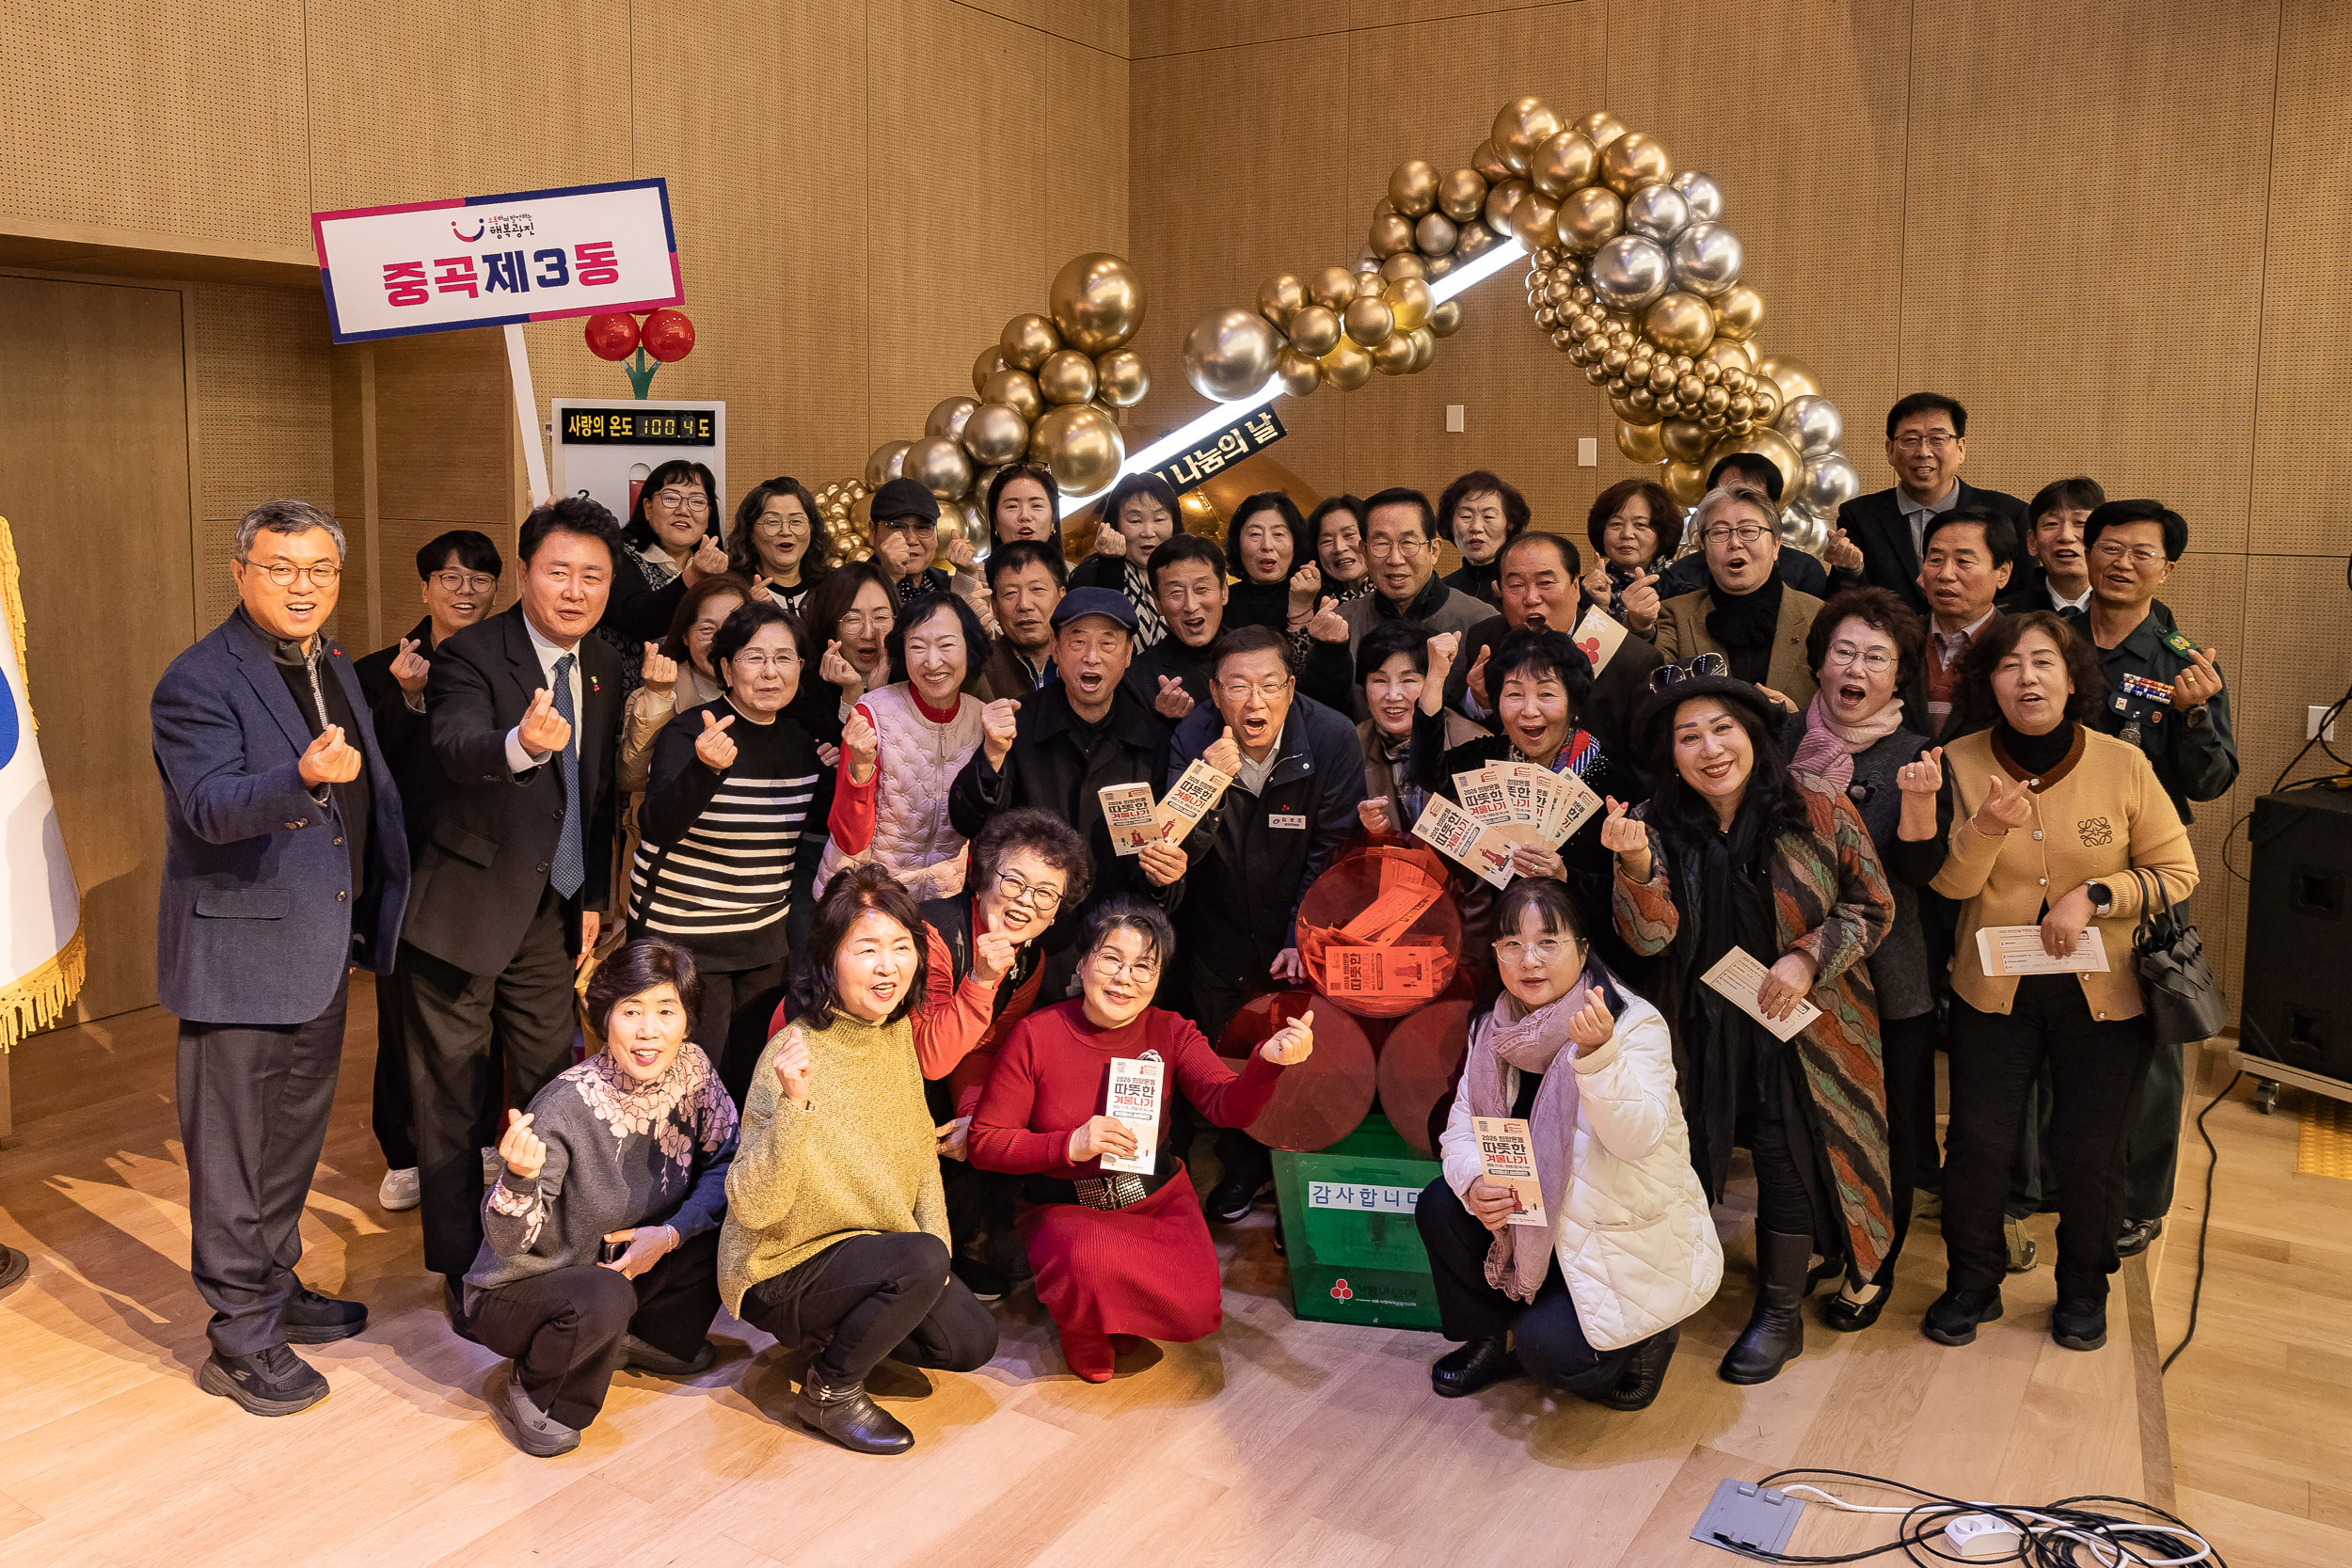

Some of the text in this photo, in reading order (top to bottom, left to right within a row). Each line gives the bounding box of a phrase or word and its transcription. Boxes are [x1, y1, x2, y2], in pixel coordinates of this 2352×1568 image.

[489, 222, 534, 239] 행복광진
[382, 241, 620, 308] 중곡제3동
[568, 415, 605, 437] 사랑의
[609, 416, 633, 437] 온도
[1169, 411, 1279, 484] 나눔의 날
[1180, 780, 1213, 801] 따뜻한
[1506, 785, 1531, 799] 뜻한
[1173, 789, 1206, 809] 겨울나기
[1465, 791, 1503, 807] 따뜻한
[1108, 801, 1149, 814] 따뜻한
[1111, 809, 1151, 819] 겨울나기
[1470, 801, 1507, 816] 겨울나기
[1435, 812, 1462, 847] 따뜻한
[1445, 817, 1470, 851] 겨울나기
[1349, 952, 1361, 990] 따뜻한
[1114, 1083, 1155, 1099] 따뜻한
[1113, 1095, 1153, 1108] 겨울나기
[1482, 1141, 1526, 1156] 따뜻한
[1485, 1153, 1528, 1164] 겨울나기
